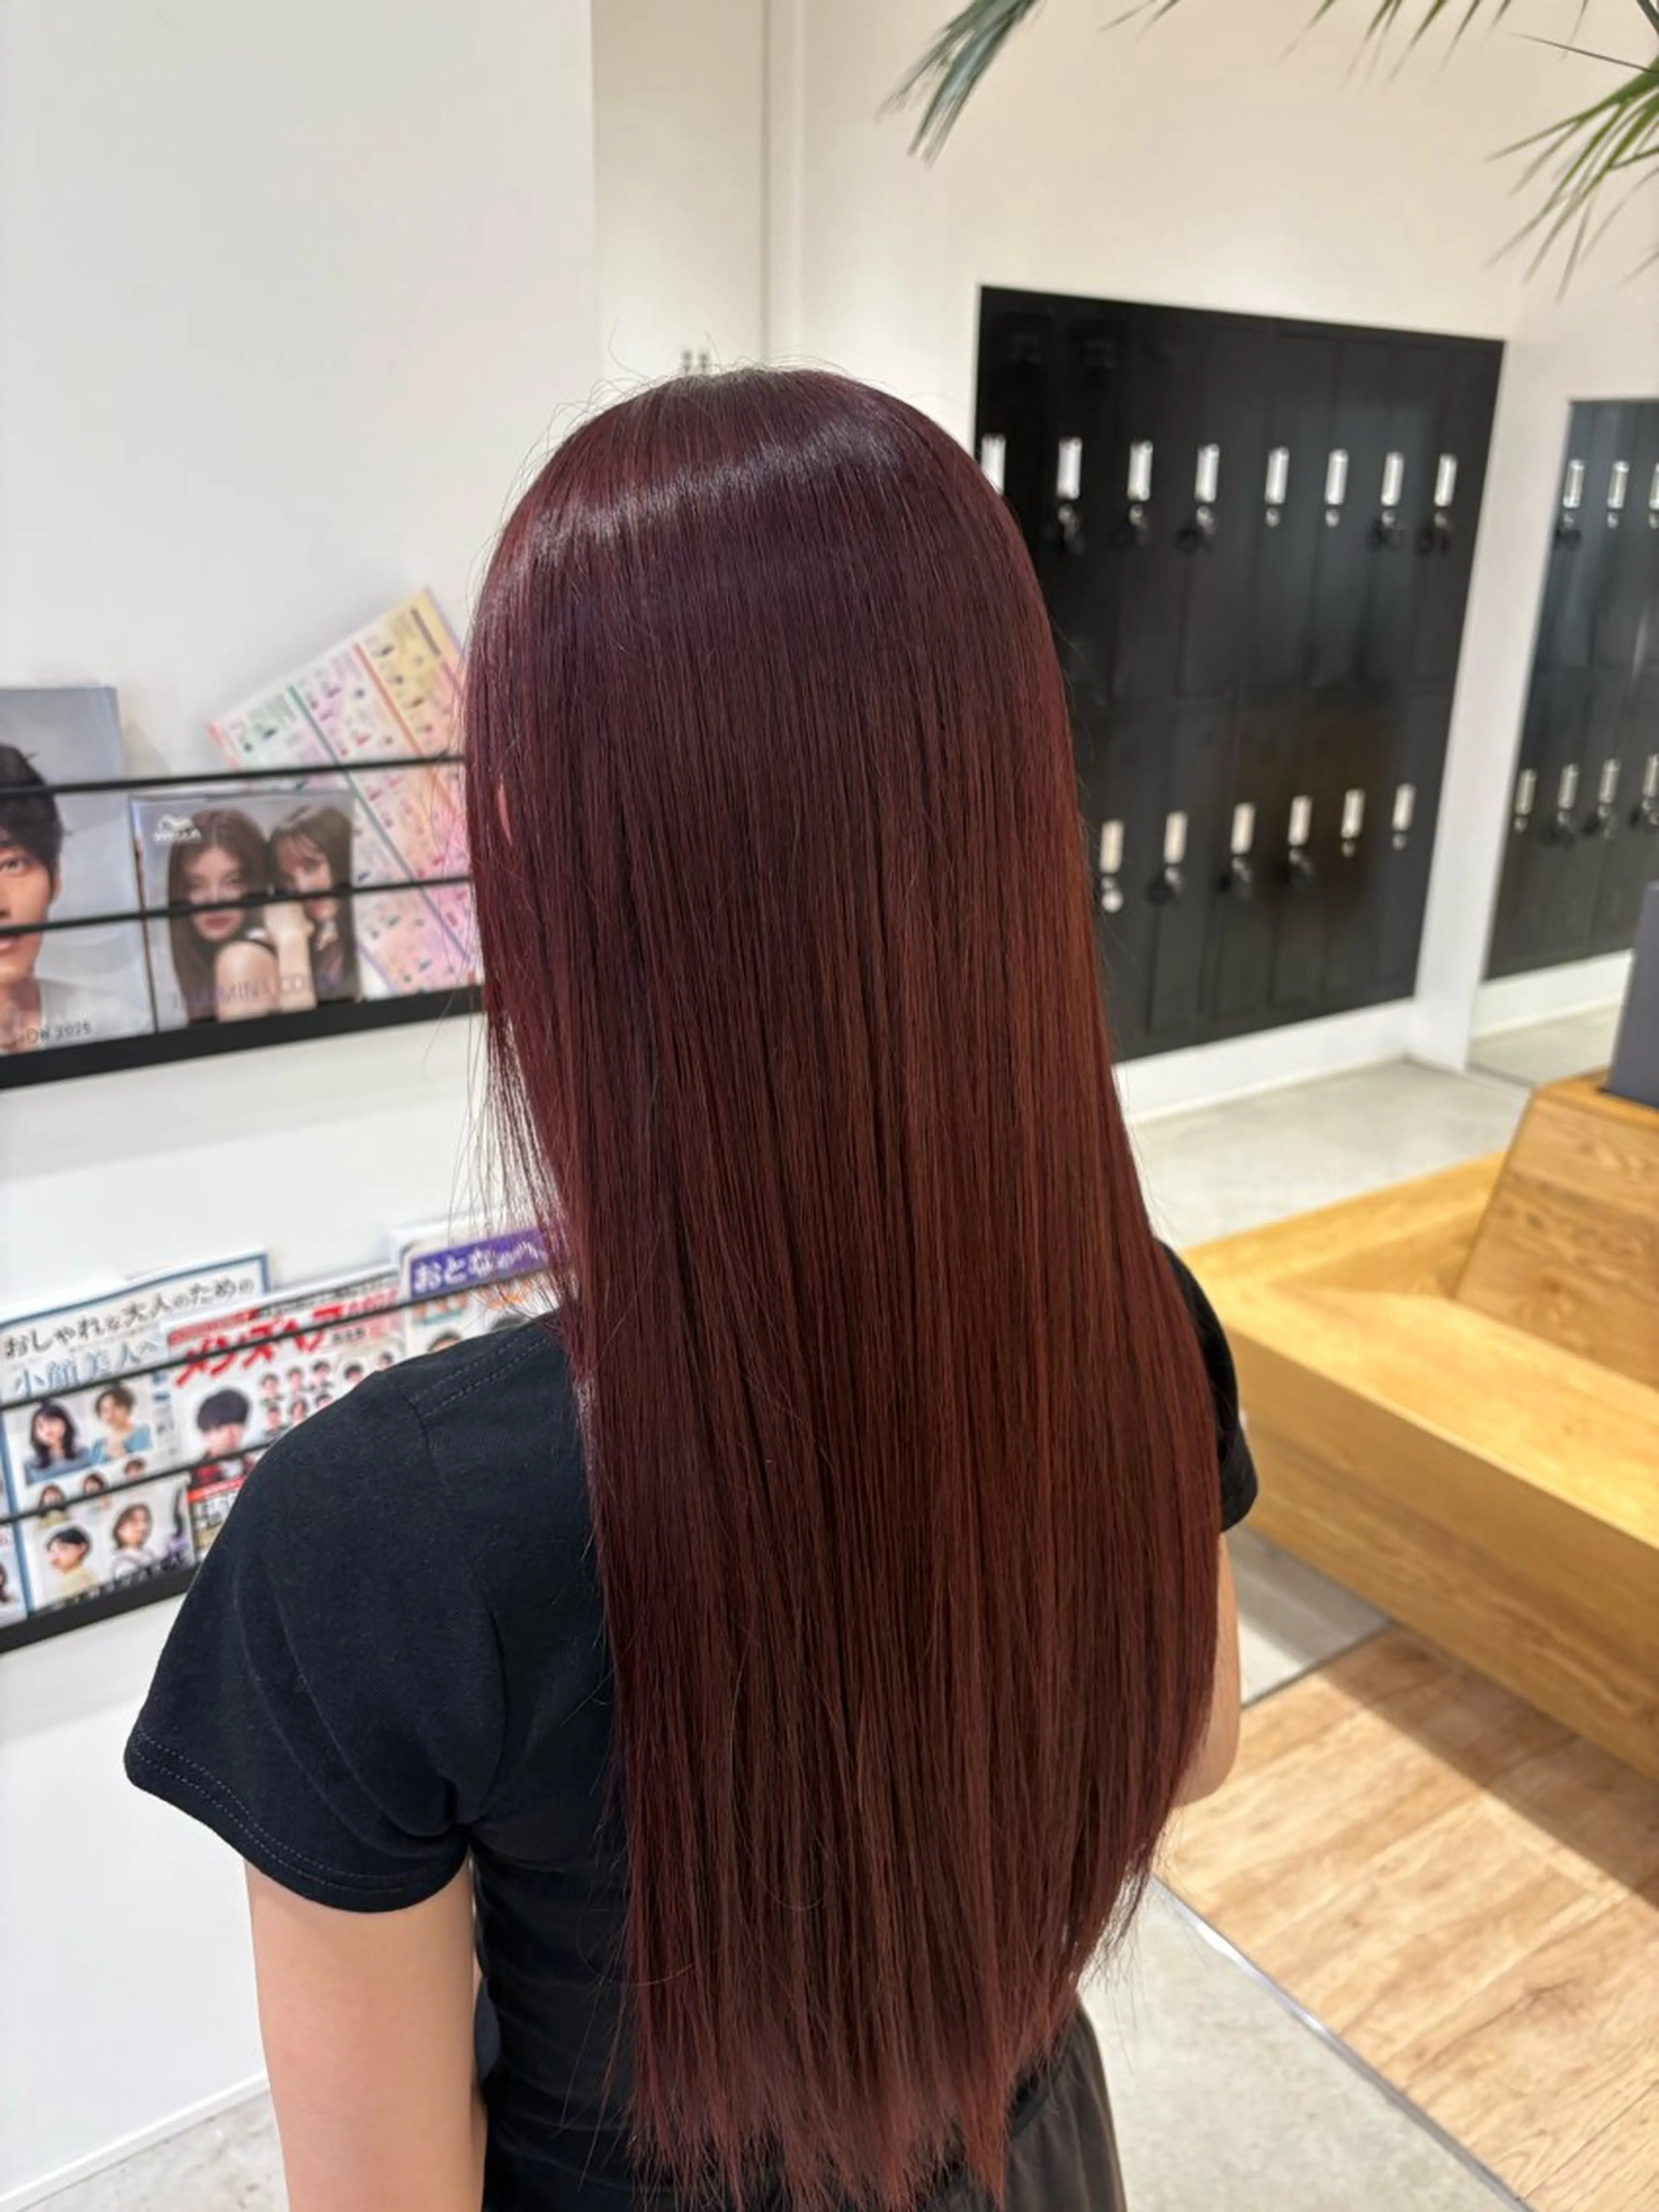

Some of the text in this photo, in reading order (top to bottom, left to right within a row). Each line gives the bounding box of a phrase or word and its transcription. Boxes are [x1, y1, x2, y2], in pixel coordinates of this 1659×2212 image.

[3, 1277, 255, 1359] おしゃれな大人のための
[16, 1340, 159, 1397] 小顔美人へ
